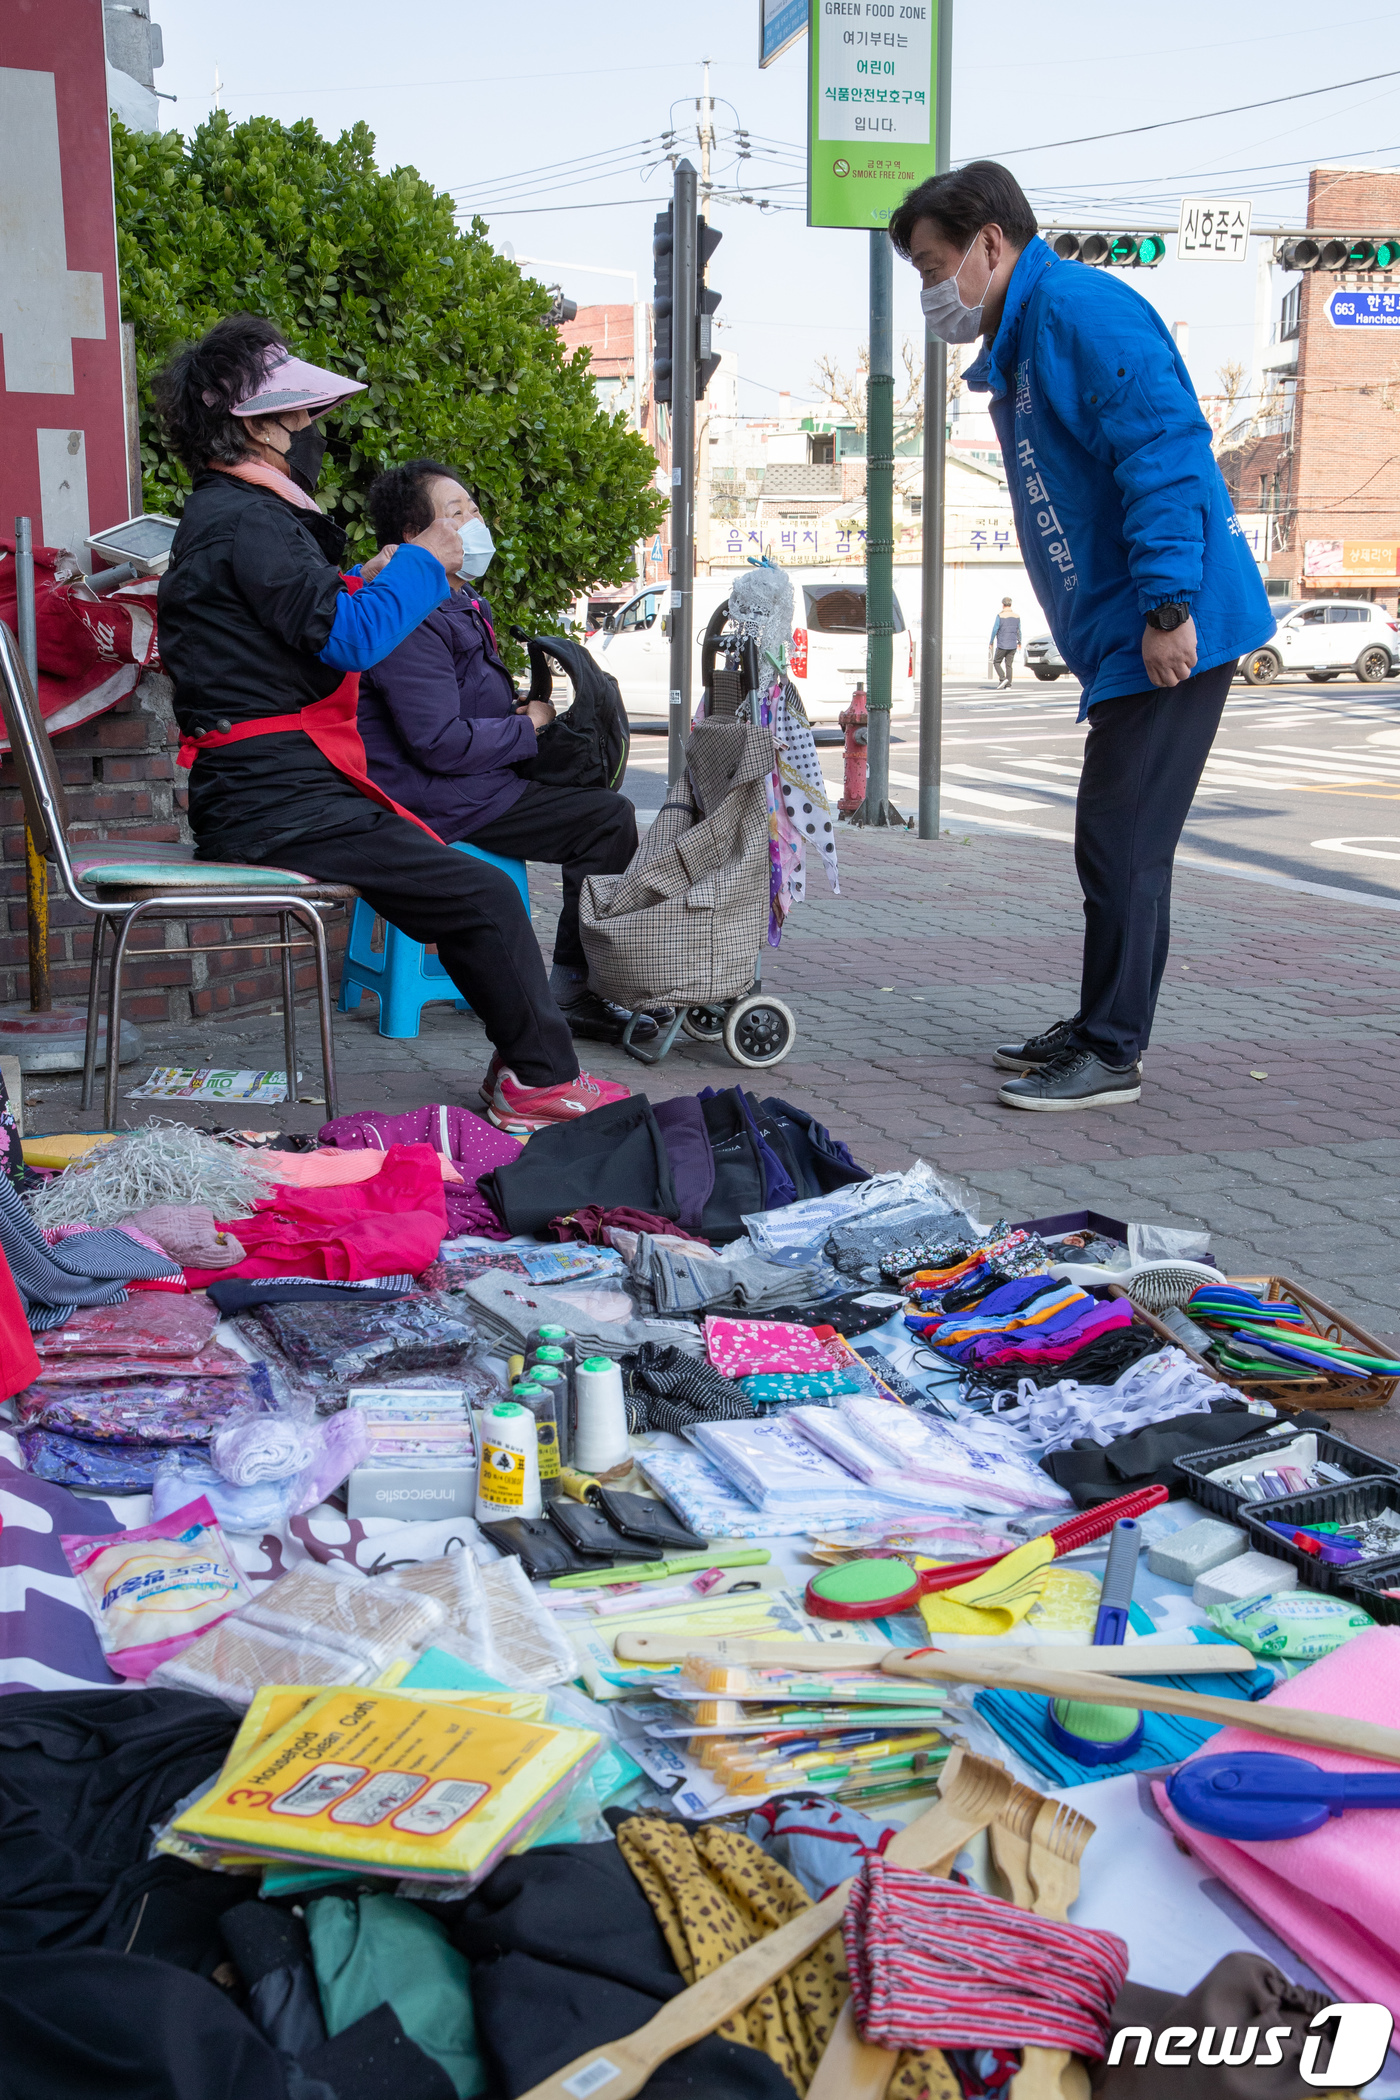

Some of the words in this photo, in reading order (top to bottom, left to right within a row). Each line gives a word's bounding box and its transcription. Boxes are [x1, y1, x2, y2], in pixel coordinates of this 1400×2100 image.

[825, 2, 860, 16] GREEN
[866, 4, 894, 17] FOOD
[900, 6, 926, 20] ZONE
[843, 31, 908, 48] 여기부터는
[857, 60, 895, 75] 어린이
[825, 87, 925, 105] 식품안전보호구역
[855, 117, 897, 132] 입니다.
[867, 160, 901, 169] 금연구역
[852, 170, 877, 178] SMOKE
[880, 171, 896, 179] FREE
[898, 171, 915, 180] ZONE
[1185, 209, 1244, 252] 신호준수
[1335, 303, 1355, 315] 663
[1018, 438, 1075, 573] 국회의원
[726, 529, 763, 553] 음치
[781, 530, 818, 553] 박치
[970, 530, 1010, 551] 주부
[100, 1569, 166, 1611] 방충제
[303, 1731, 344, 1760] Clean
[340, 1700, 378, 1727] Cloth
[248, 1731, 319, 1785] Household
[226, 1788, 274, 1809] 3
